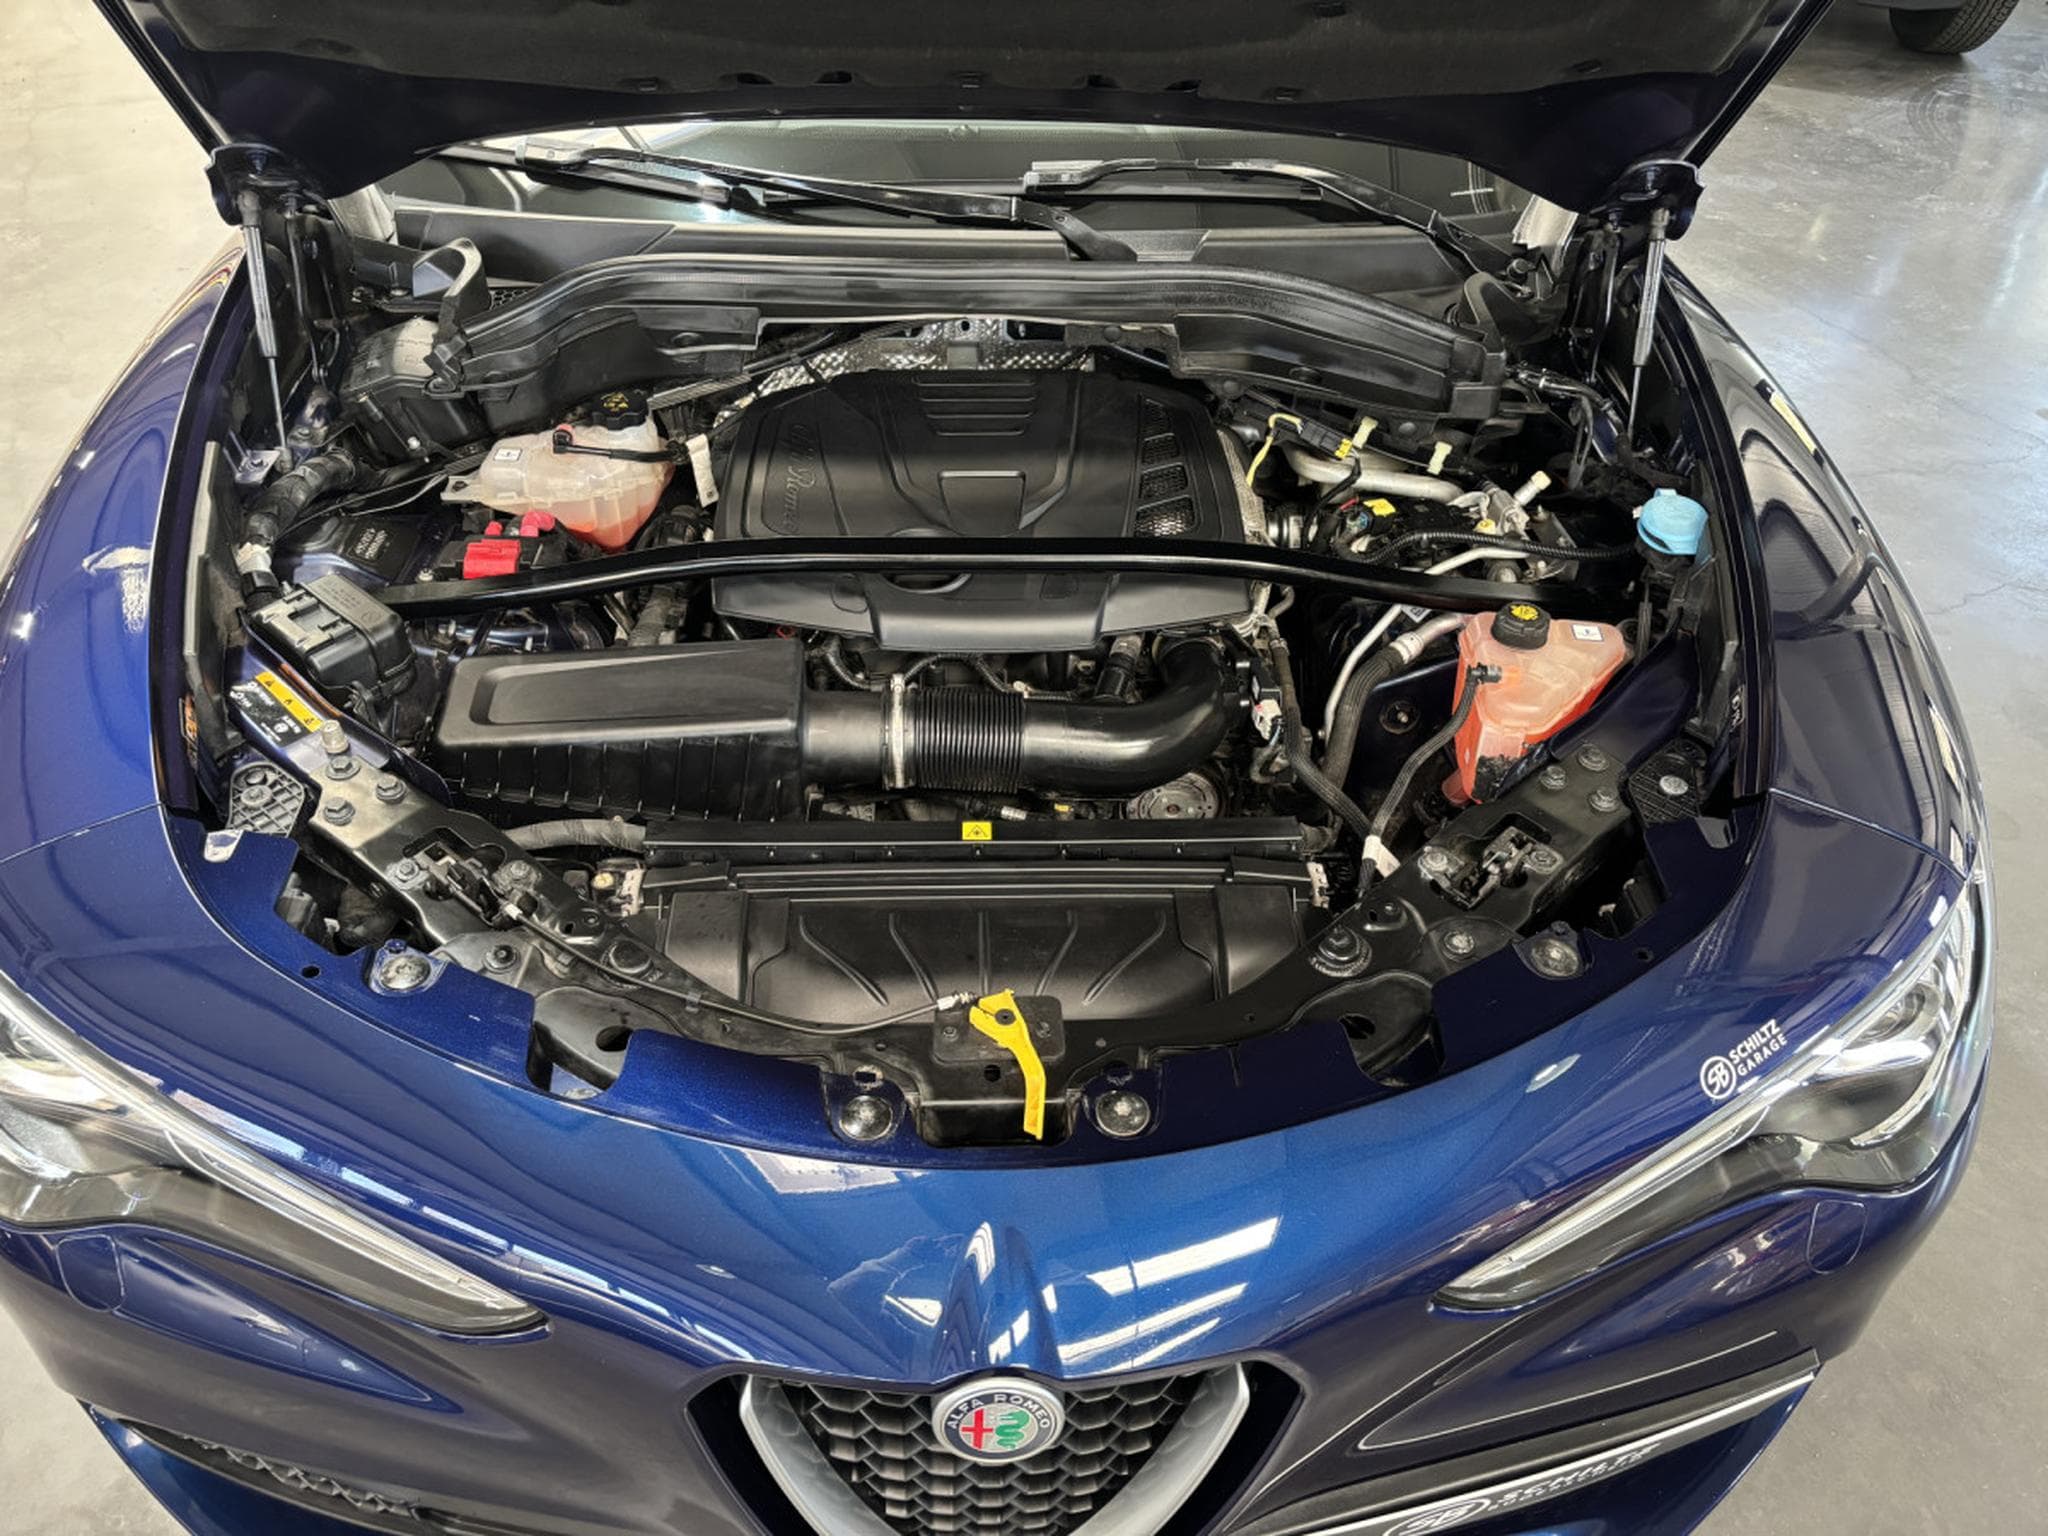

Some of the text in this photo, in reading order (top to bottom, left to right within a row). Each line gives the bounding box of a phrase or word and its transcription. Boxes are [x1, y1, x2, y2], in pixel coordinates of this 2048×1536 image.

[1729, 1018, 1781, 1065] SCHILTZ
[1737, 1033, 1788, 1076] GARAGE
[947, 1393, 1050, 1430] ALFA ROMEO
